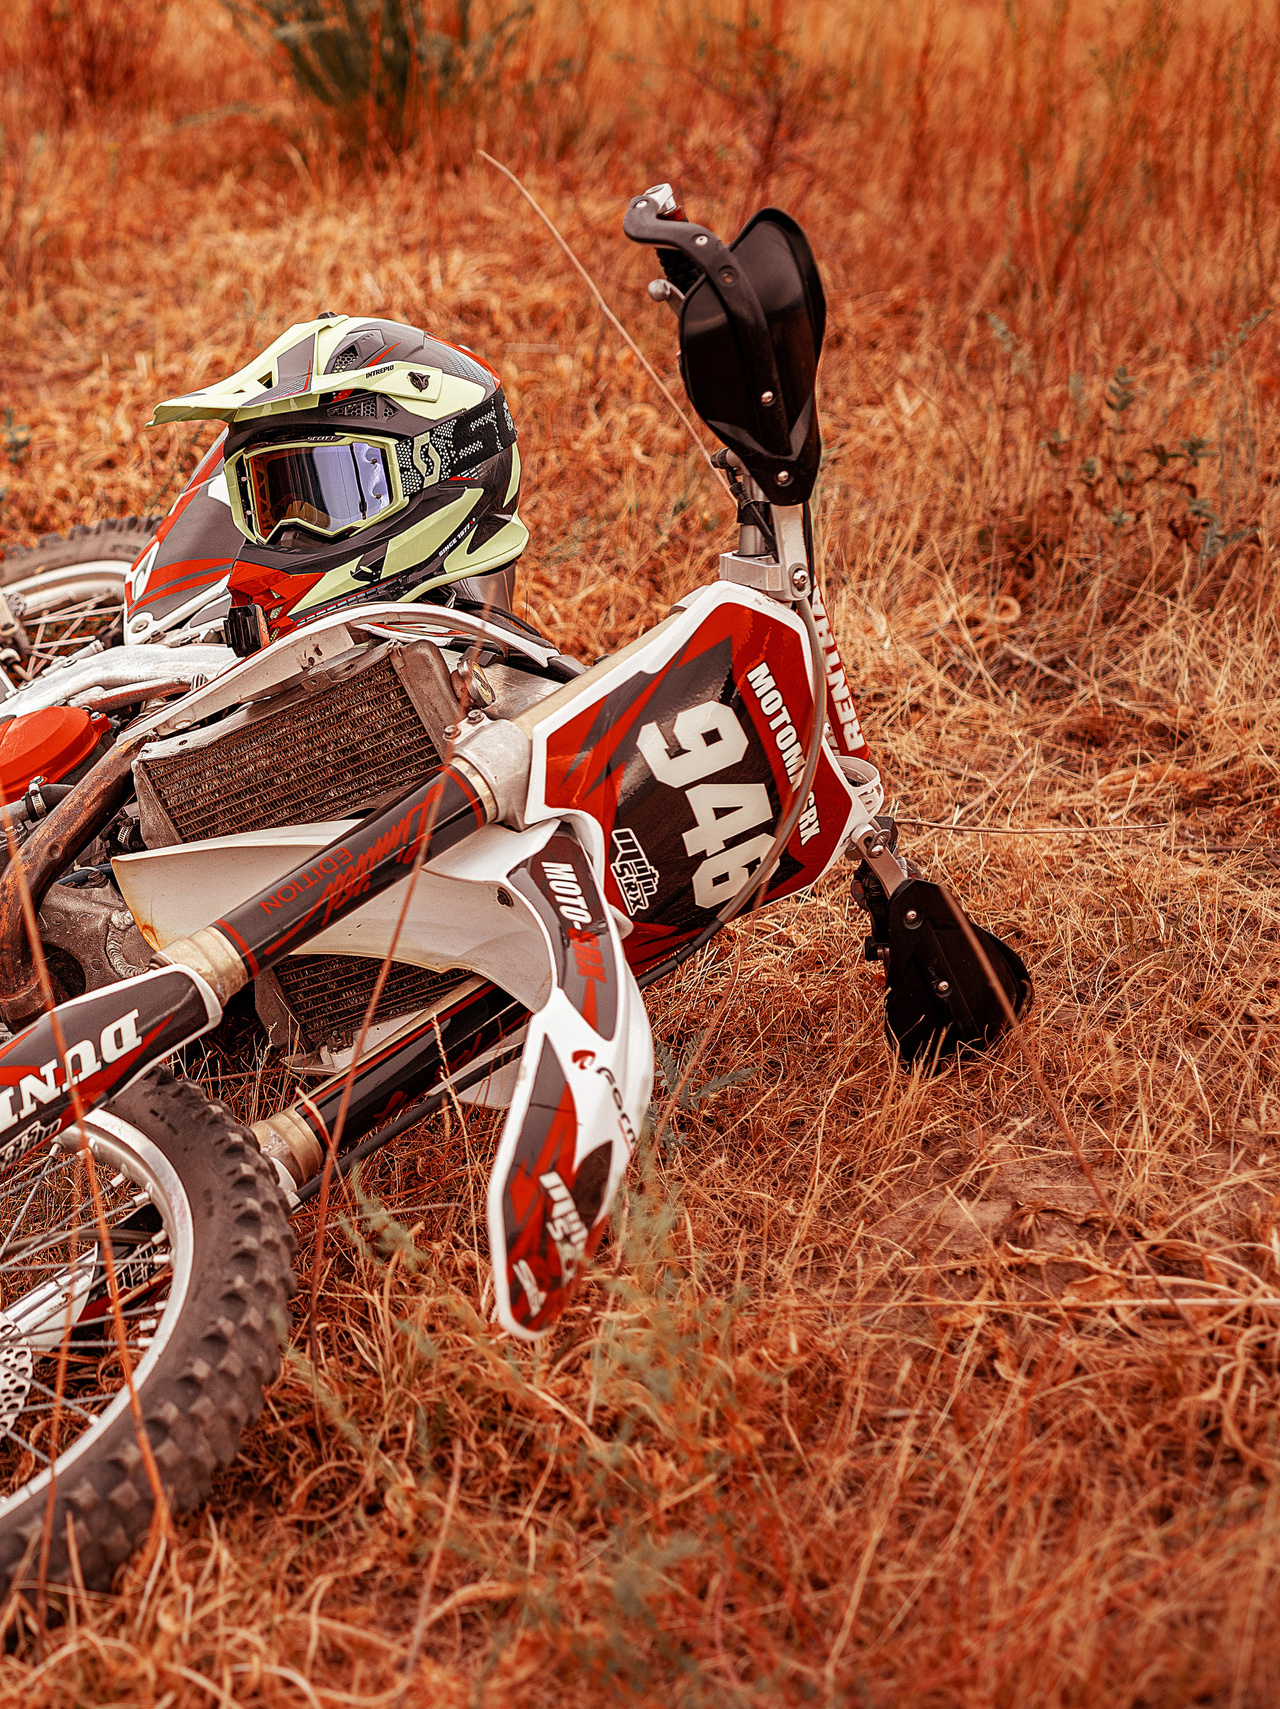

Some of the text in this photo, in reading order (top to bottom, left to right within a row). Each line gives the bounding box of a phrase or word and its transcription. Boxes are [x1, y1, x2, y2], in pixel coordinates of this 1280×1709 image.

[438, 522, 470, 557] SINCE 1977
[811, 575, 866, 752] RENTHA
[635, 700, 781, 909] 946
[257, 845, 355, 916] EDITION
